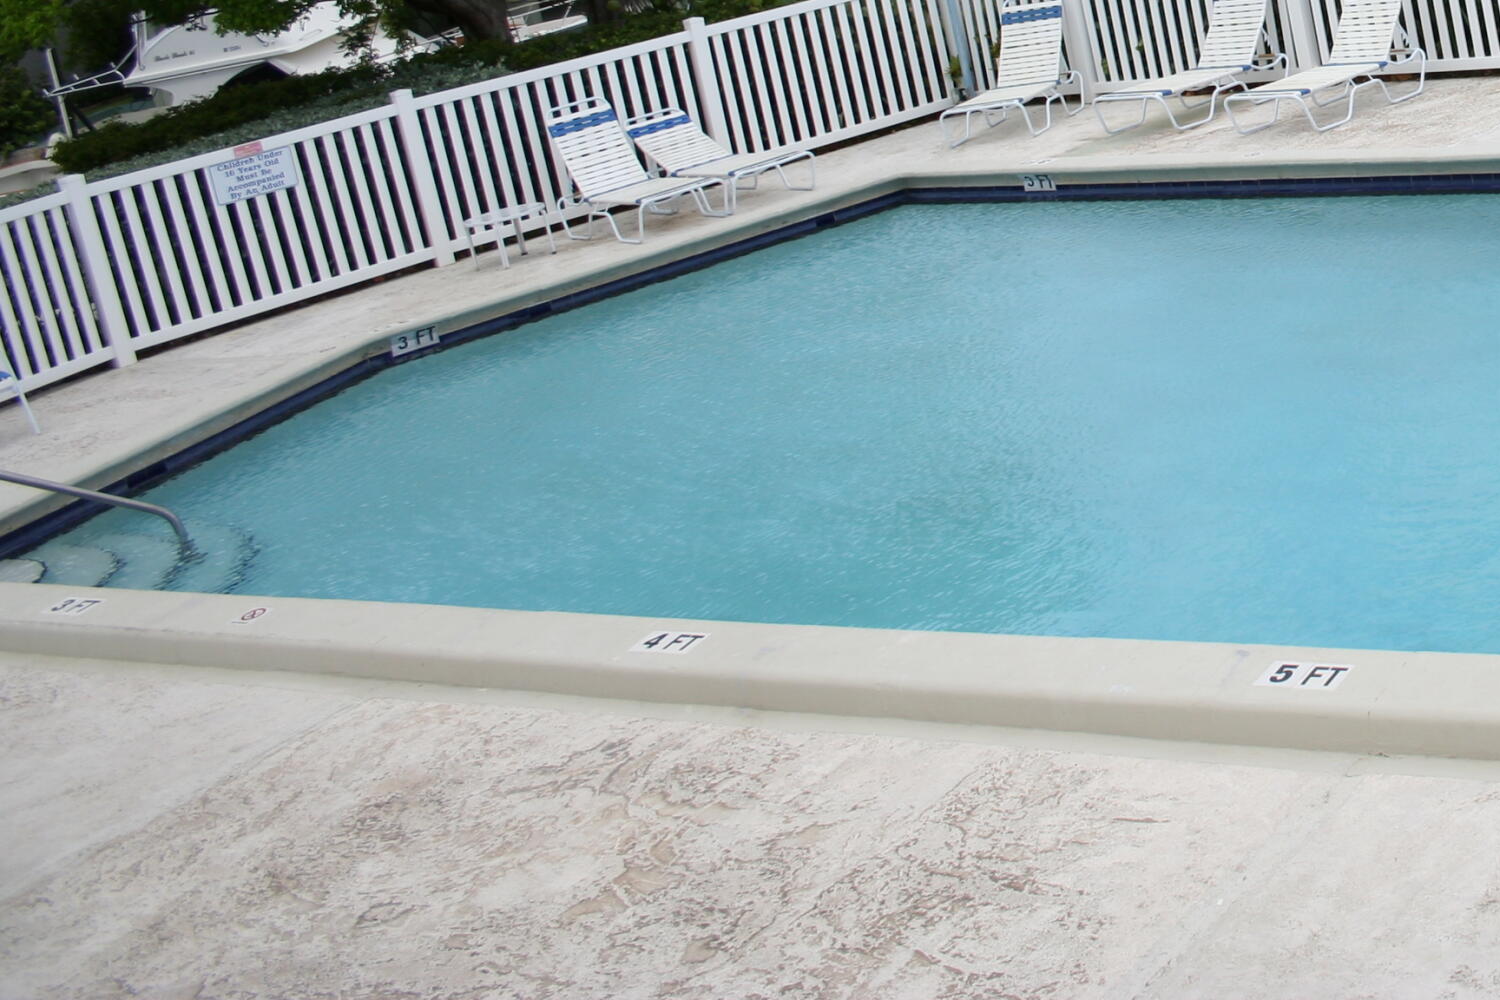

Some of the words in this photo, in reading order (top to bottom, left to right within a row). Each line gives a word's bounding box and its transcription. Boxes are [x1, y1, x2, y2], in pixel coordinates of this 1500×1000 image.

[217, 158, 254, 171] Children
[256, 150, 283, 161] Under
[237, 163, 262, 174] Years
[264, 158, 280, 167] Old
[228, 171, 286, 193] Accompanied
[236, 172, 258, 182] Must
[261, 168, 272, 176] Be
[1035, 174, 1053, 189] FT
[230, 191, 241, 200] By
[246, 188, 259, 196] An
[261, 180, 286, 192] Adult
[398, 336, 408, 350] 3
[416, 325, 436, 345] FT
[51, 599, 76, 612] 3
[65, 600, 101, 613] FT
[643, 633, 669, 649] 4
[662, 633, 705, 651] FT
[1269, 663, 1299, 683] 5
[1300, 666, 1349, 687] FT
